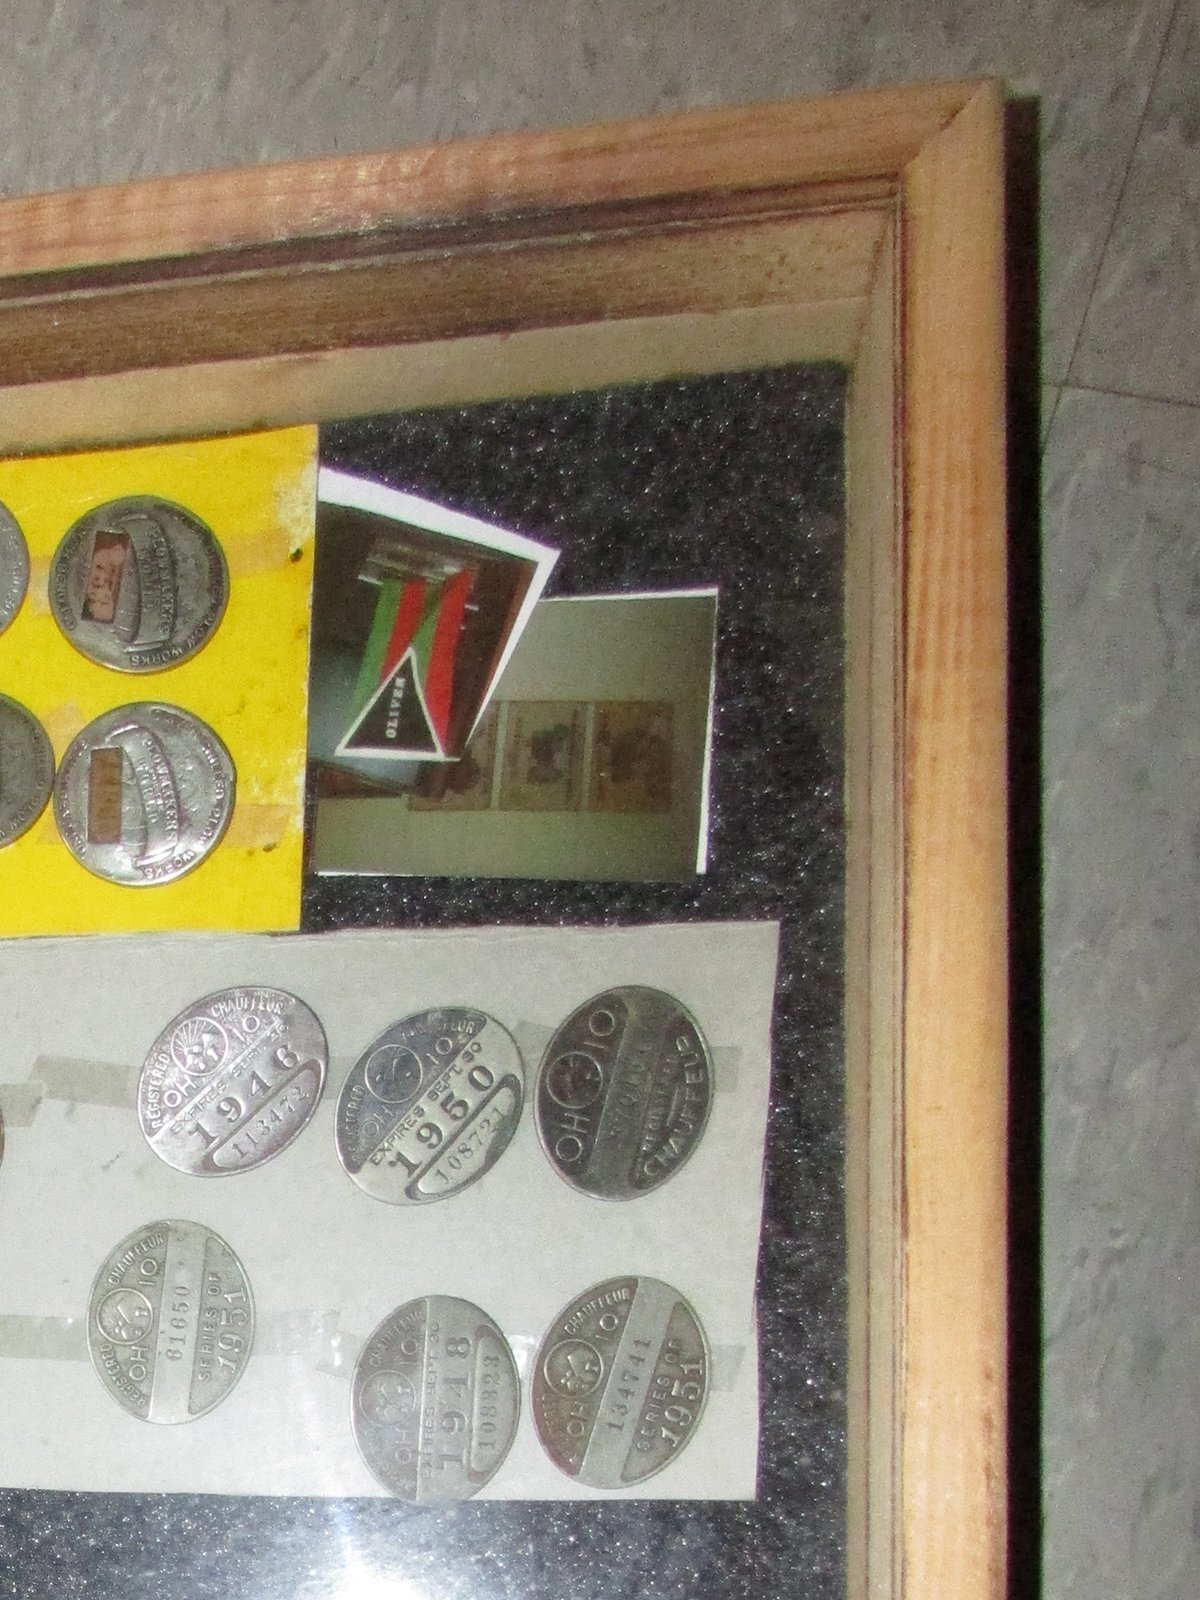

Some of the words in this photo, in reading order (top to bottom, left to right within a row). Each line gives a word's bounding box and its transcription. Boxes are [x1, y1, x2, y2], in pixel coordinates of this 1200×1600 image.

[384, 676, 407, 739] OLIVER
[144, 850, 196, 879] WORKS
[148, 1053, 170, 1128] REGISTERED
[209, 997, 284, 1017] CHAUFFEUR
[188, 1044, 298, 1149] 1946
[370, 1106, 425, 1165] EXPIRES
[461, 1042, 482, 1063] 30
[171, 1080, 226, 1133] EXPIRES
[232, 1086, 309, 1158] 113472
[388, 1065, 494, 1177] 1950
[435, 1107, 504, 1184] 108721
[108, 1232, 163, 1285] CHAUFFEUR
[198, 1308, 217, 1381] SERIES
[208, 1272, 221, 1296] OF
[216, 1288, 247, 1373] 1951
[564, 1288, 630, 1334] CHAUFFEUR
[100, 1343, 148, 1405] REGISTERED
[434, 1336, 471, 1471] 1948
[607, 1340, 650, 1431] 134741
[637, 1376, 669, 1449] SERIES
[665, 1339, 680, 1363] OF
[661, 1360, 702, 1447] 1951
